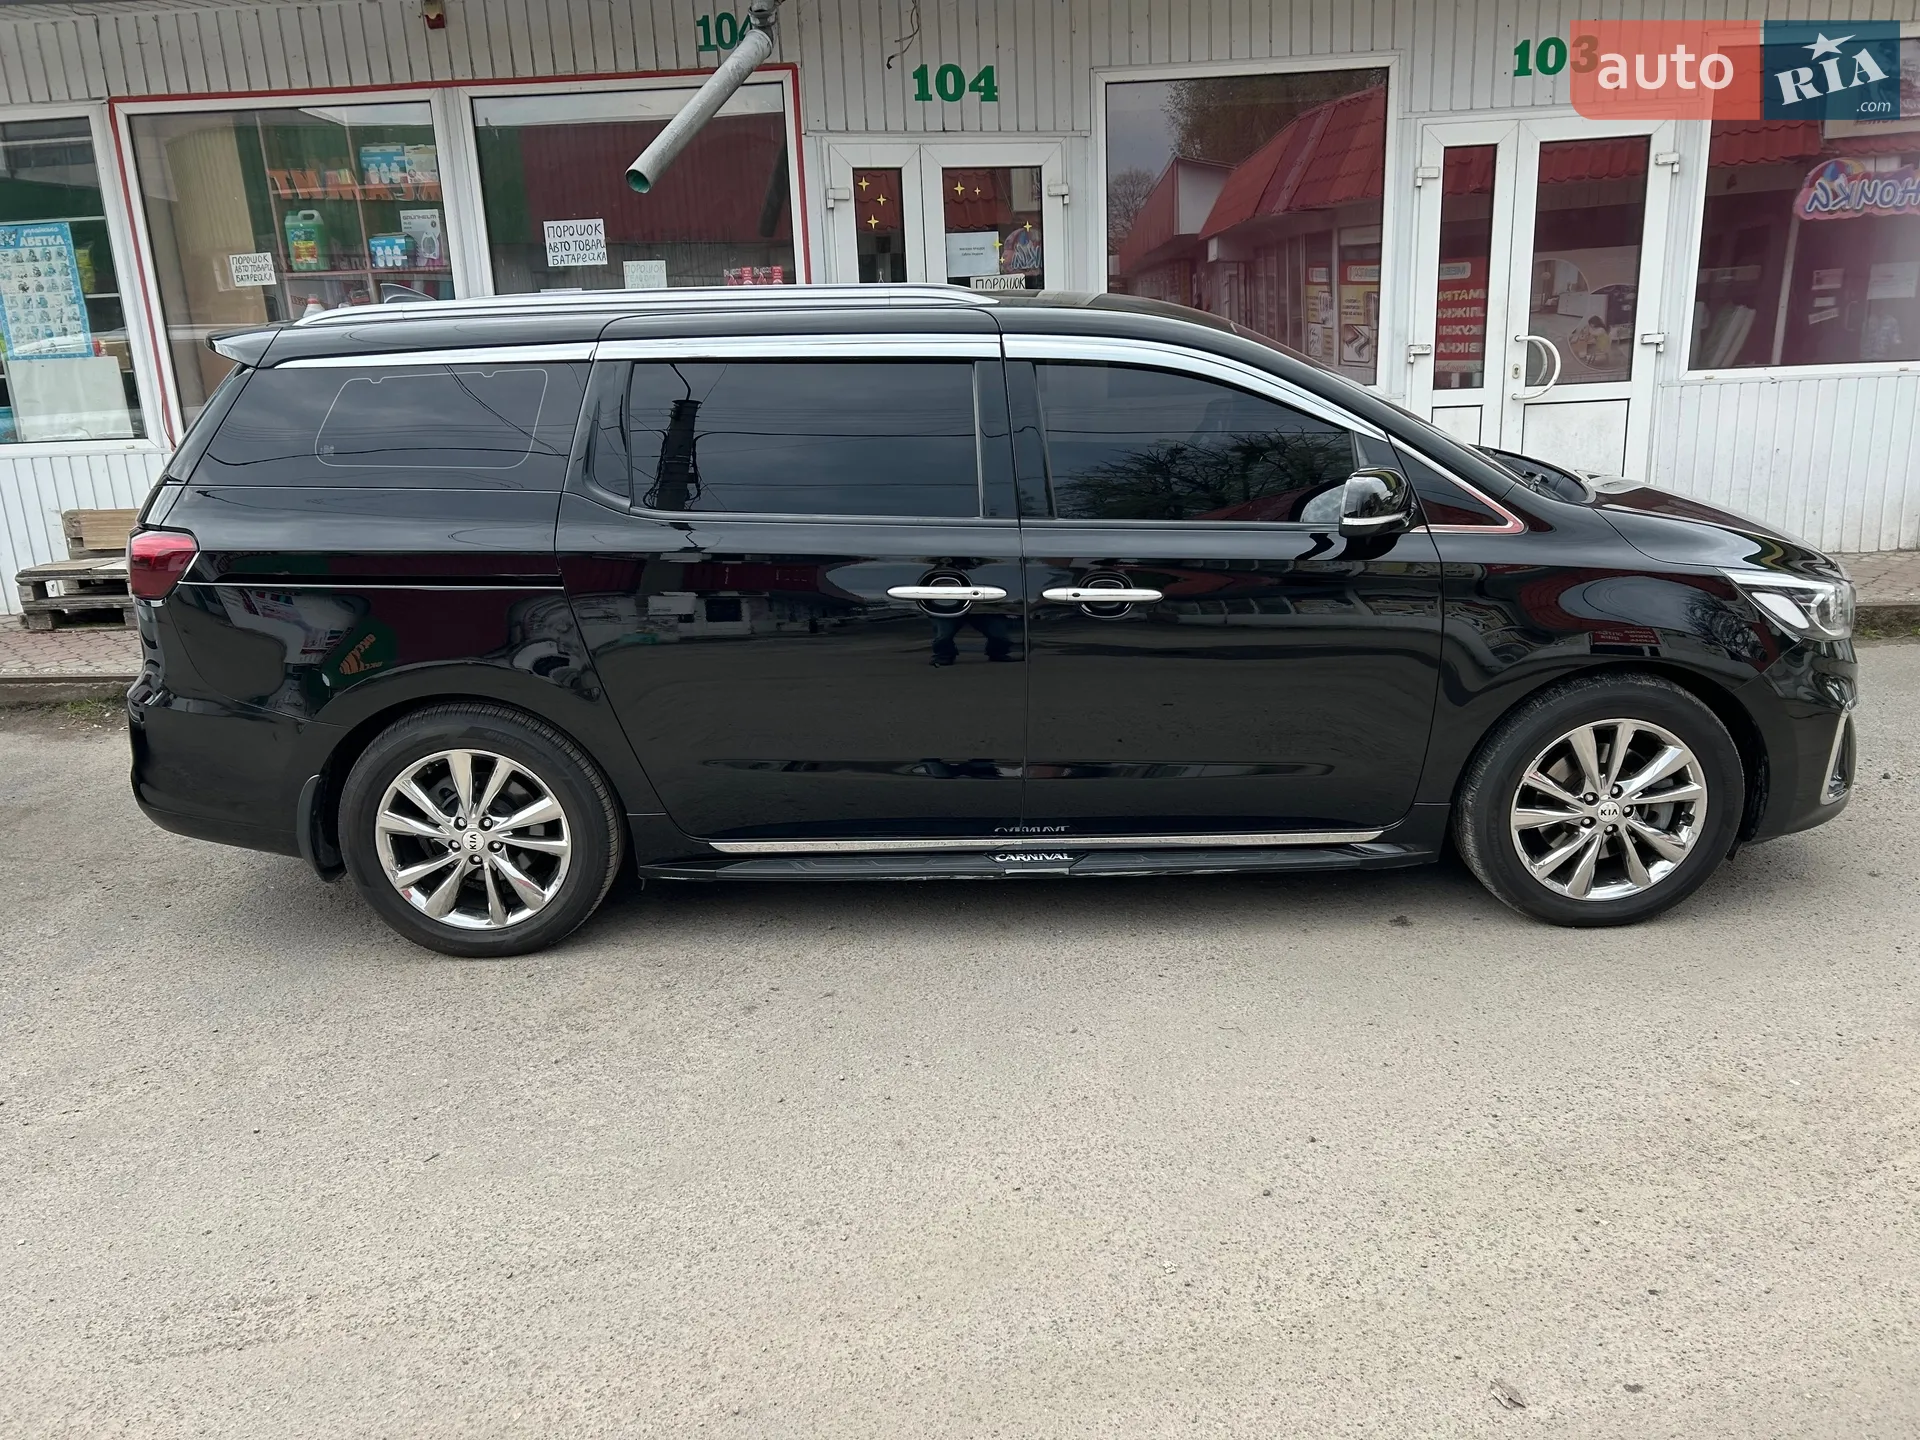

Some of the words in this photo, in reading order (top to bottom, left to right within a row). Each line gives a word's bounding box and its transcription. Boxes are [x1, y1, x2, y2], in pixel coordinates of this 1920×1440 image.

[1513, 34, 1599, 78] 103
[912, 63, 999, 103] 104
[546, 223, 603, 239] ПОРОШОК
[20, 235, 65, 247] АБЕТКА
[231, 254, 270, 266] ПОРОШОК
[624, 263, 666, 274] ПОРОШОК
[975, 277, 1026, 289] ПОРОШОК
[1600, 808, 1618, 816] KIA
[469, 833, 477, 850] KIA
[996, 852, 1074, 862] CARNIVAL
